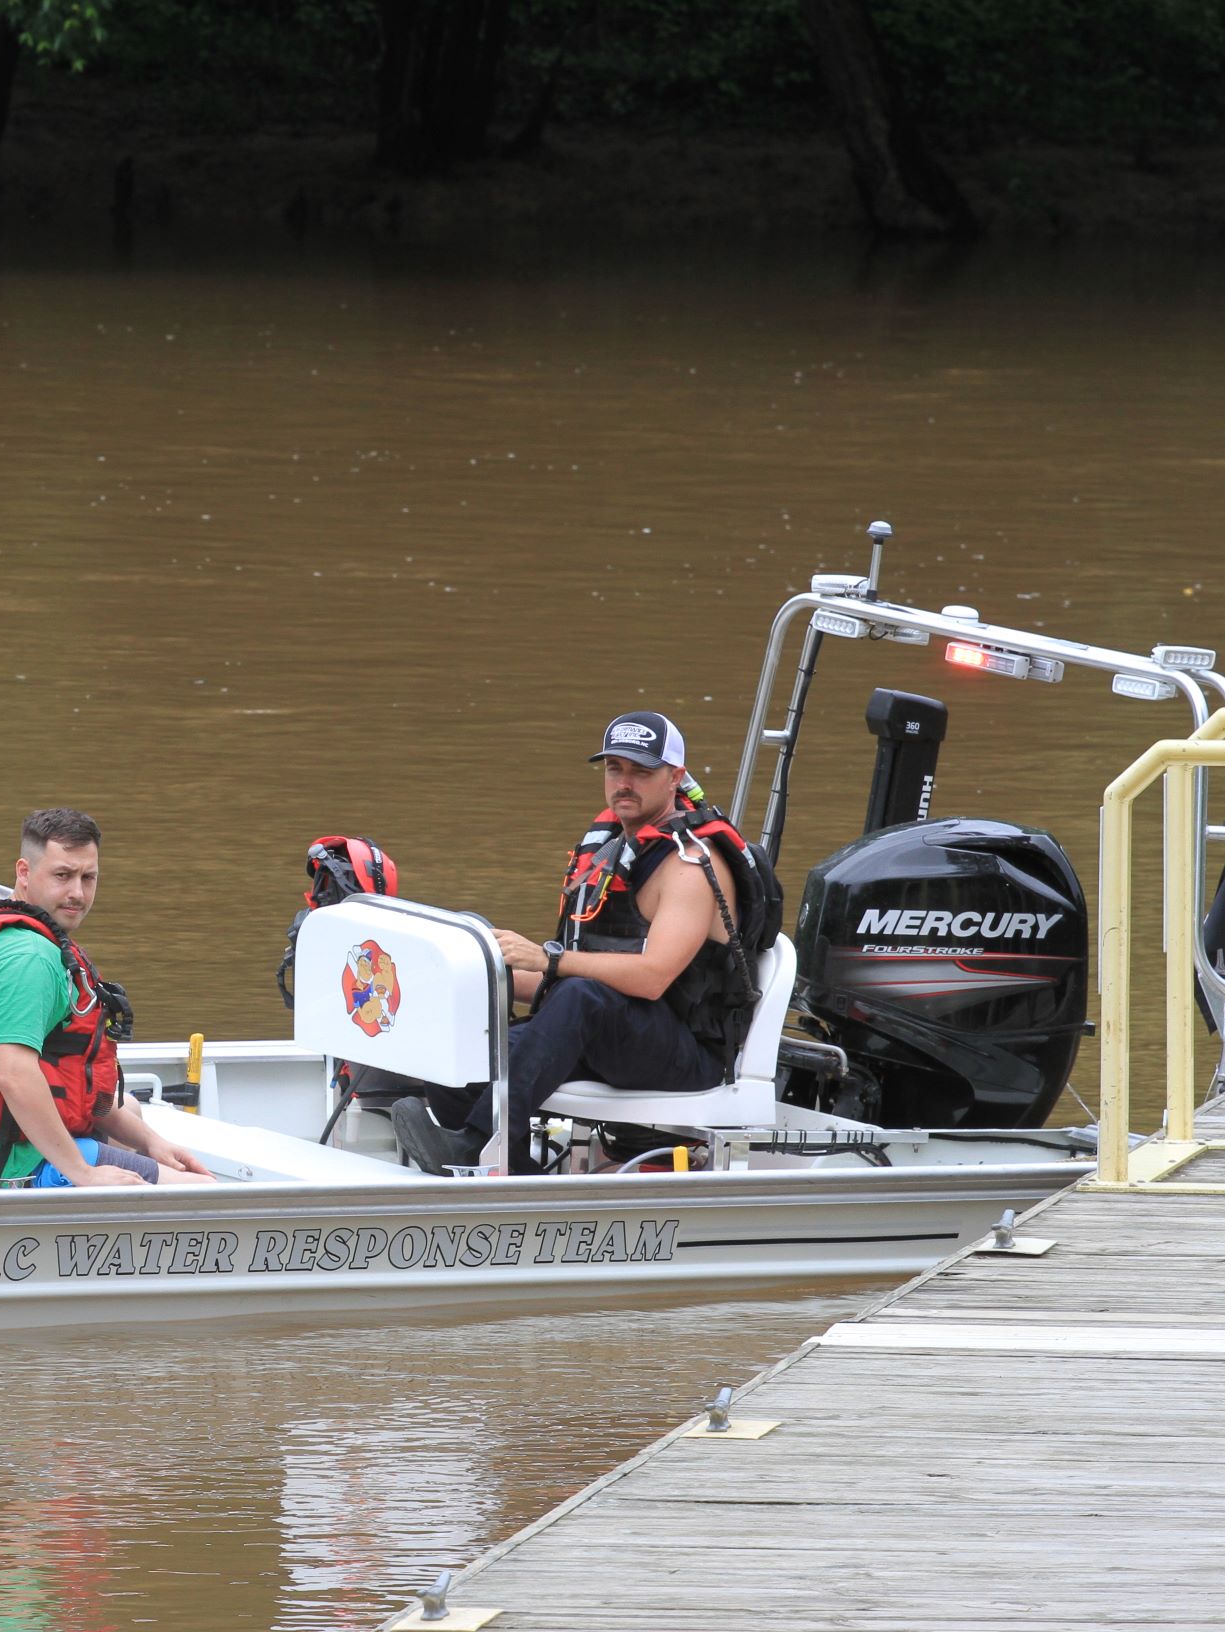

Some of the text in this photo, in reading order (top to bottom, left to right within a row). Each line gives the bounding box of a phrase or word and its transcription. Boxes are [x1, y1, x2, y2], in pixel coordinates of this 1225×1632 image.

[905, 721, 920, 731] 360
[856, 908, 1063, 939] MERCURY
[861, 944, 984, 956] FOURSTROKE
[55, 1231, 239, 1277] WATER
[248, 1222, 527, 1274] RESPONSE
[533, 1219, 680, 1264] TEAM
